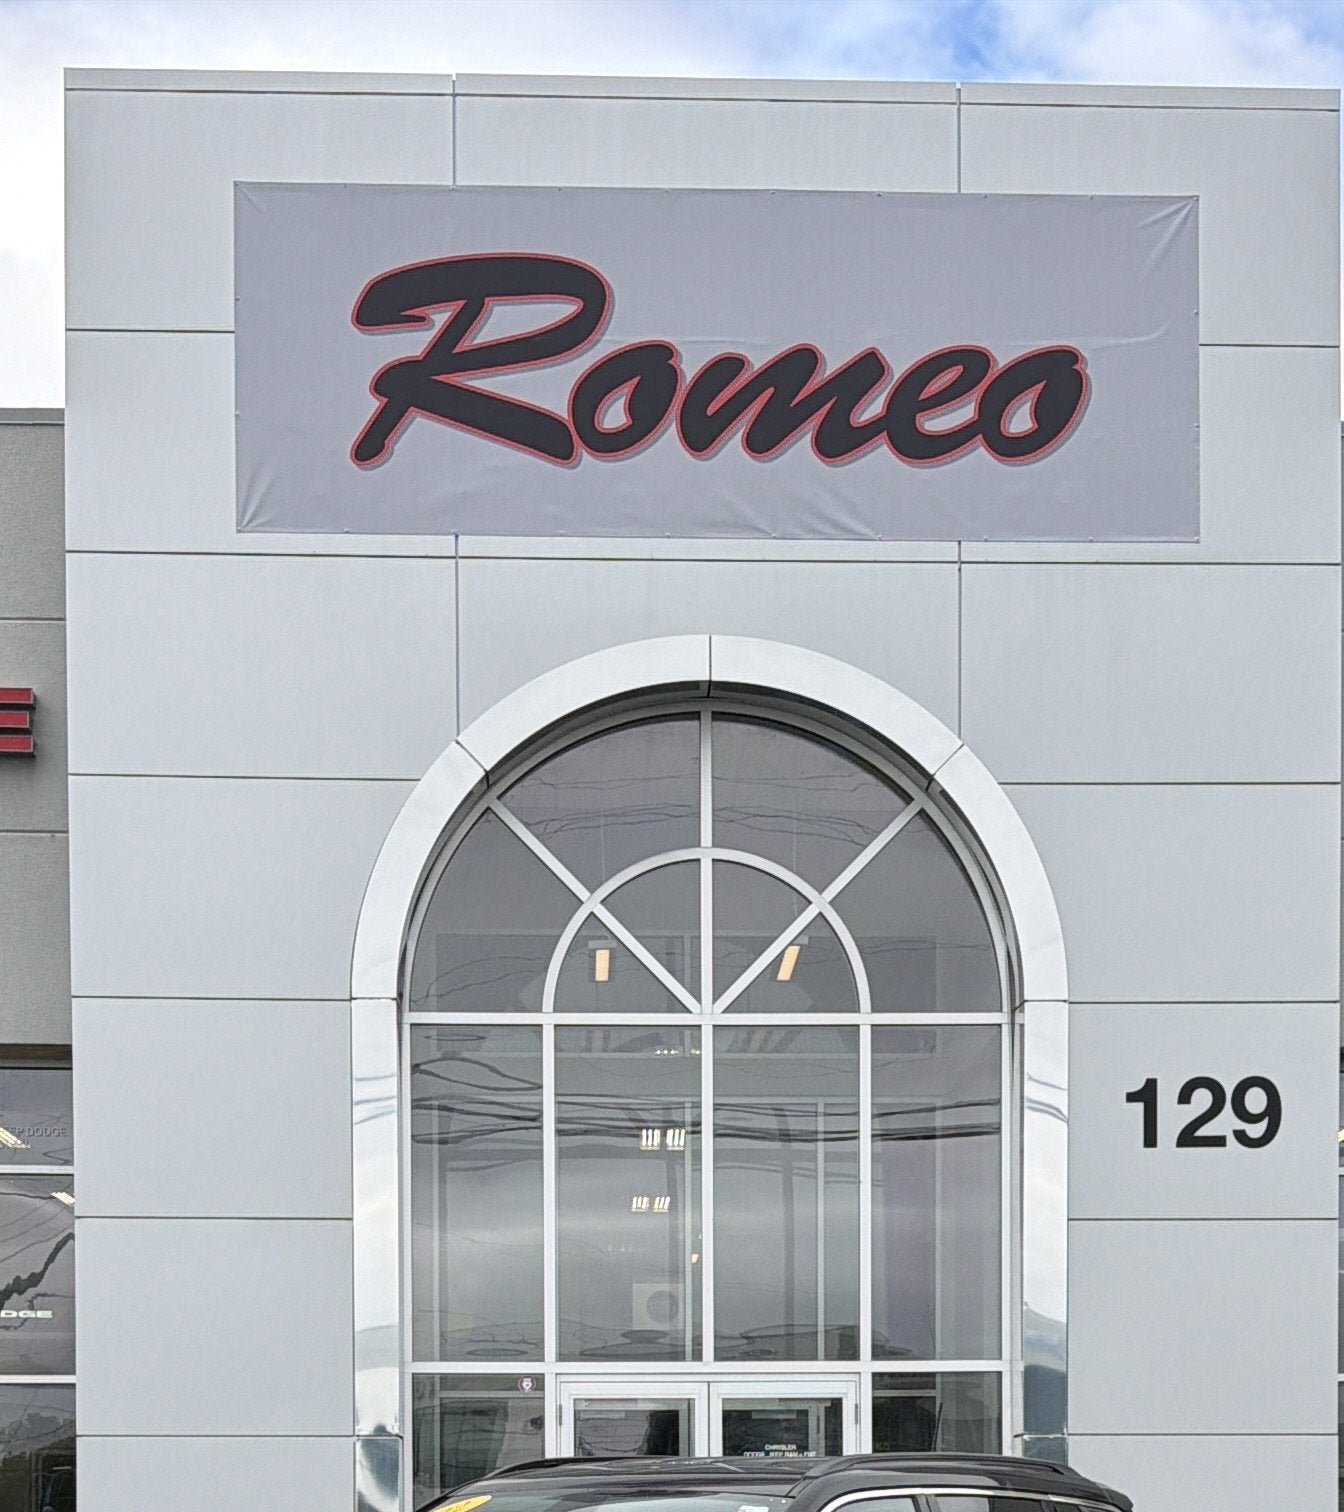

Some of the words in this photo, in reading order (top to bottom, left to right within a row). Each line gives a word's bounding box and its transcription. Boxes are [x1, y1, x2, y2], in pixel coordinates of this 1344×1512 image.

[350, 252, 1089, 468] Romeo
[26, 1127, 67, 1136] DODGE
[1126, 1076, 1282, 1148] 129
